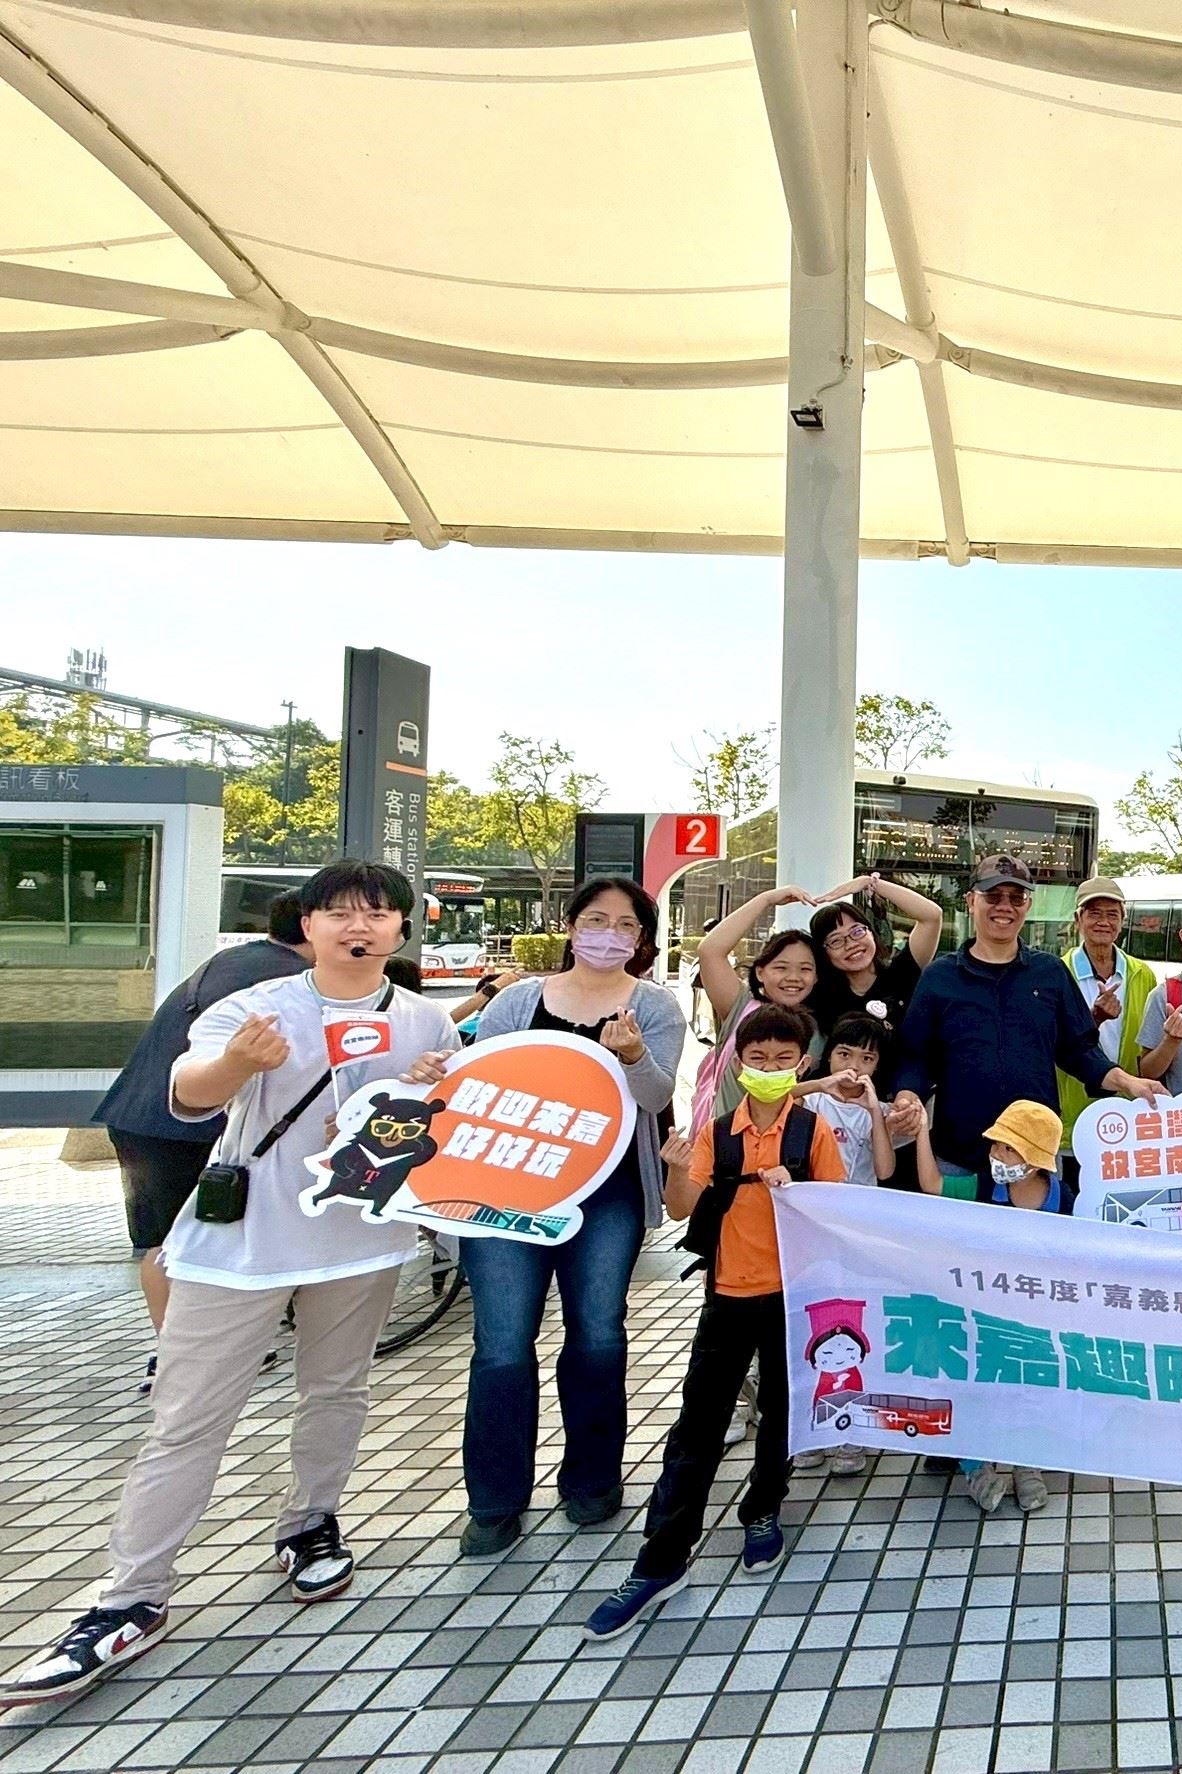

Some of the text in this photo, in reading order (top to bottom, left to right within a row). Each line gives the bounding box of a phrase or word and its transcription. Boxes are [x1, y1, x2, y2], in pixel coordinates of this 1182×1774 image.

[0, 766, 81, 791] 訊看板
[408, 793, 421, 823] Bus
[686, 818, 708, 853] 2
[446, 1077, 611, 1145] 歡迎來嘉
[1101, 1123, 1124, 1135] 106
[441, 1122, 572, 1179] 好好玩
